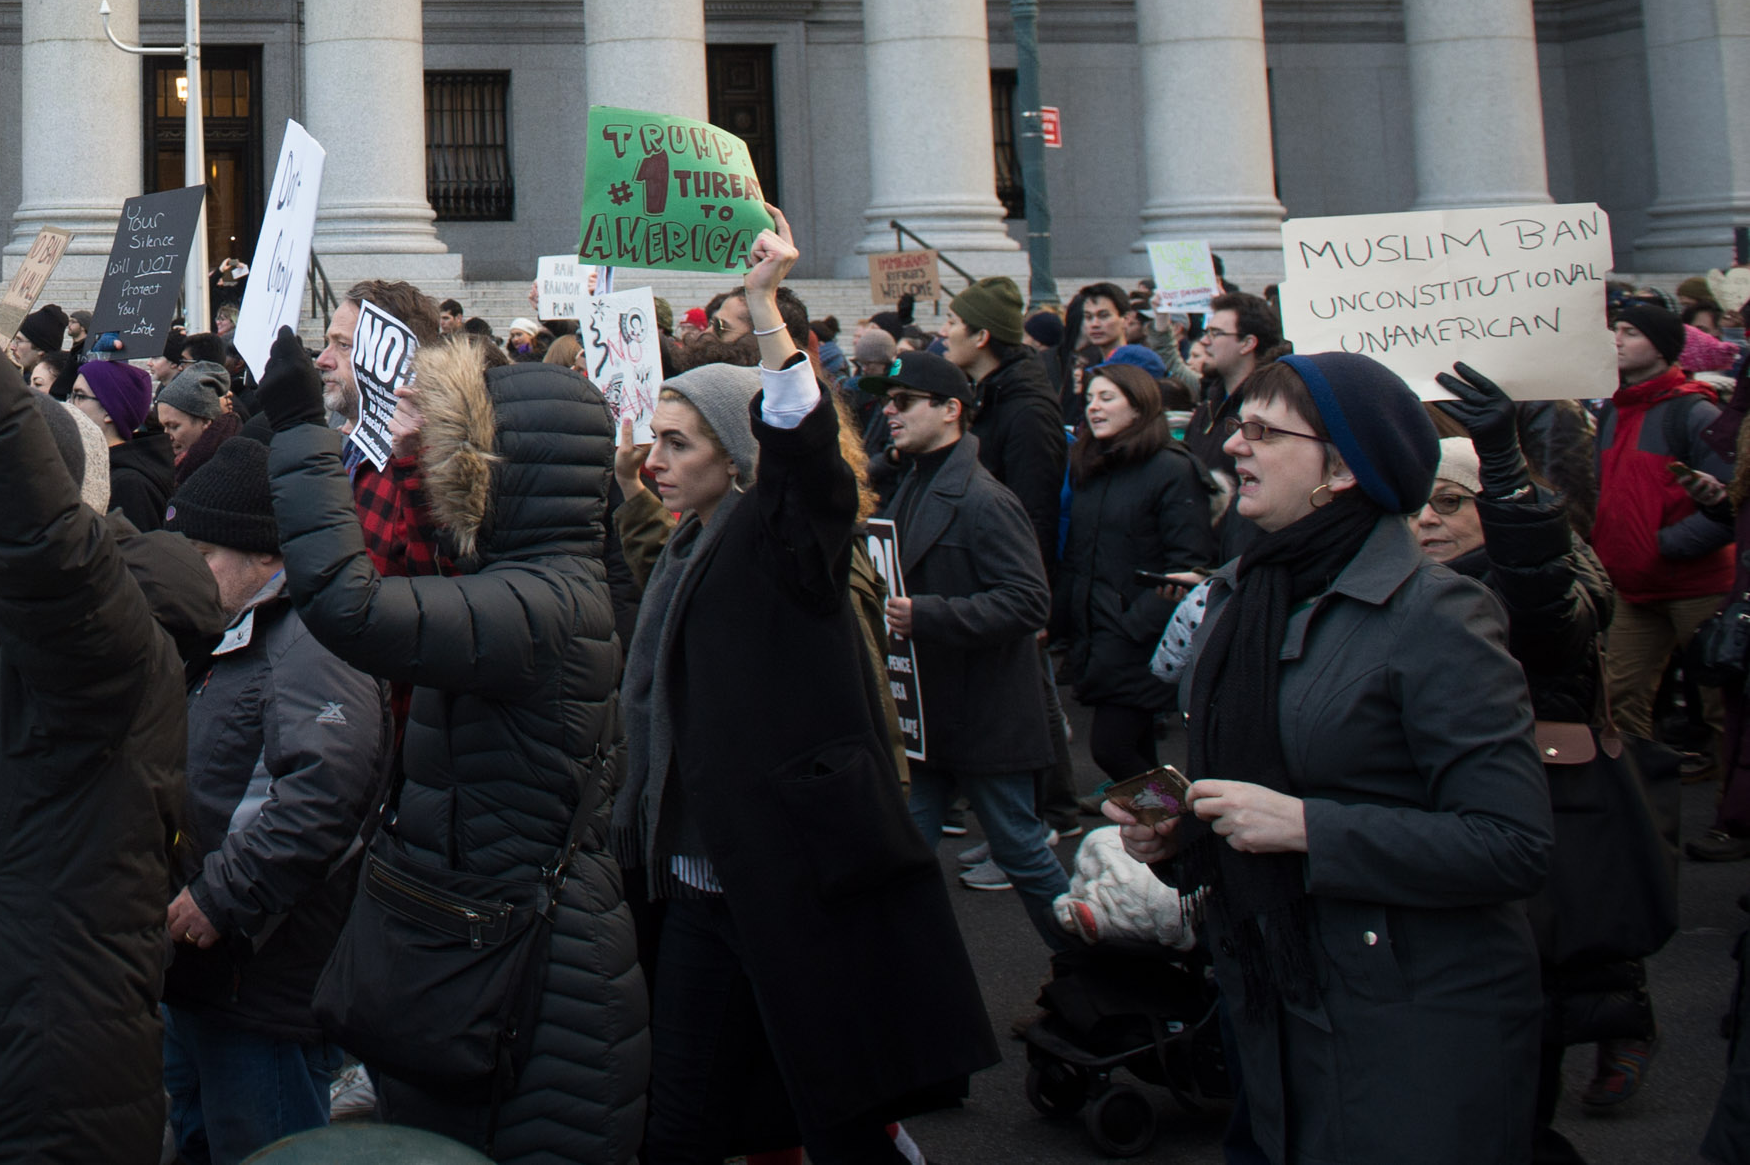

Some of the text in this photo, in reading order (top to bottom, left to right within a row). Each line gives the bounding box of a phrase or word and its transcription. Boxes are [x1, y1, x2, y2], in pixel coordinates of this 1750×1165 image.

[673, 170, 761, 201] THREAT
[127, 205, 165, 232] Your
[700, 204, 734, 222] TO
[129, 234, 175, 249] Silence
[579, 213, 754, 269] AMERICA
[1299, 211, 1599, 270] MUSLIM BAN
[136, 254, 179, 275] NOT
[553, 262, 575, 277] BAN
[121, 279, 162, 298] Protect
[879, 279, 934, 299] WELCOME
[1310, 262, 1603, 320] UNCONSTITUTIONAL
[552, 302, 575, 317] PLAN
[1341, 307, 1561, 355] UN-AMERICAN
[355, 311, 417, 389] NO!
[606, 333, 643, 367] NO
